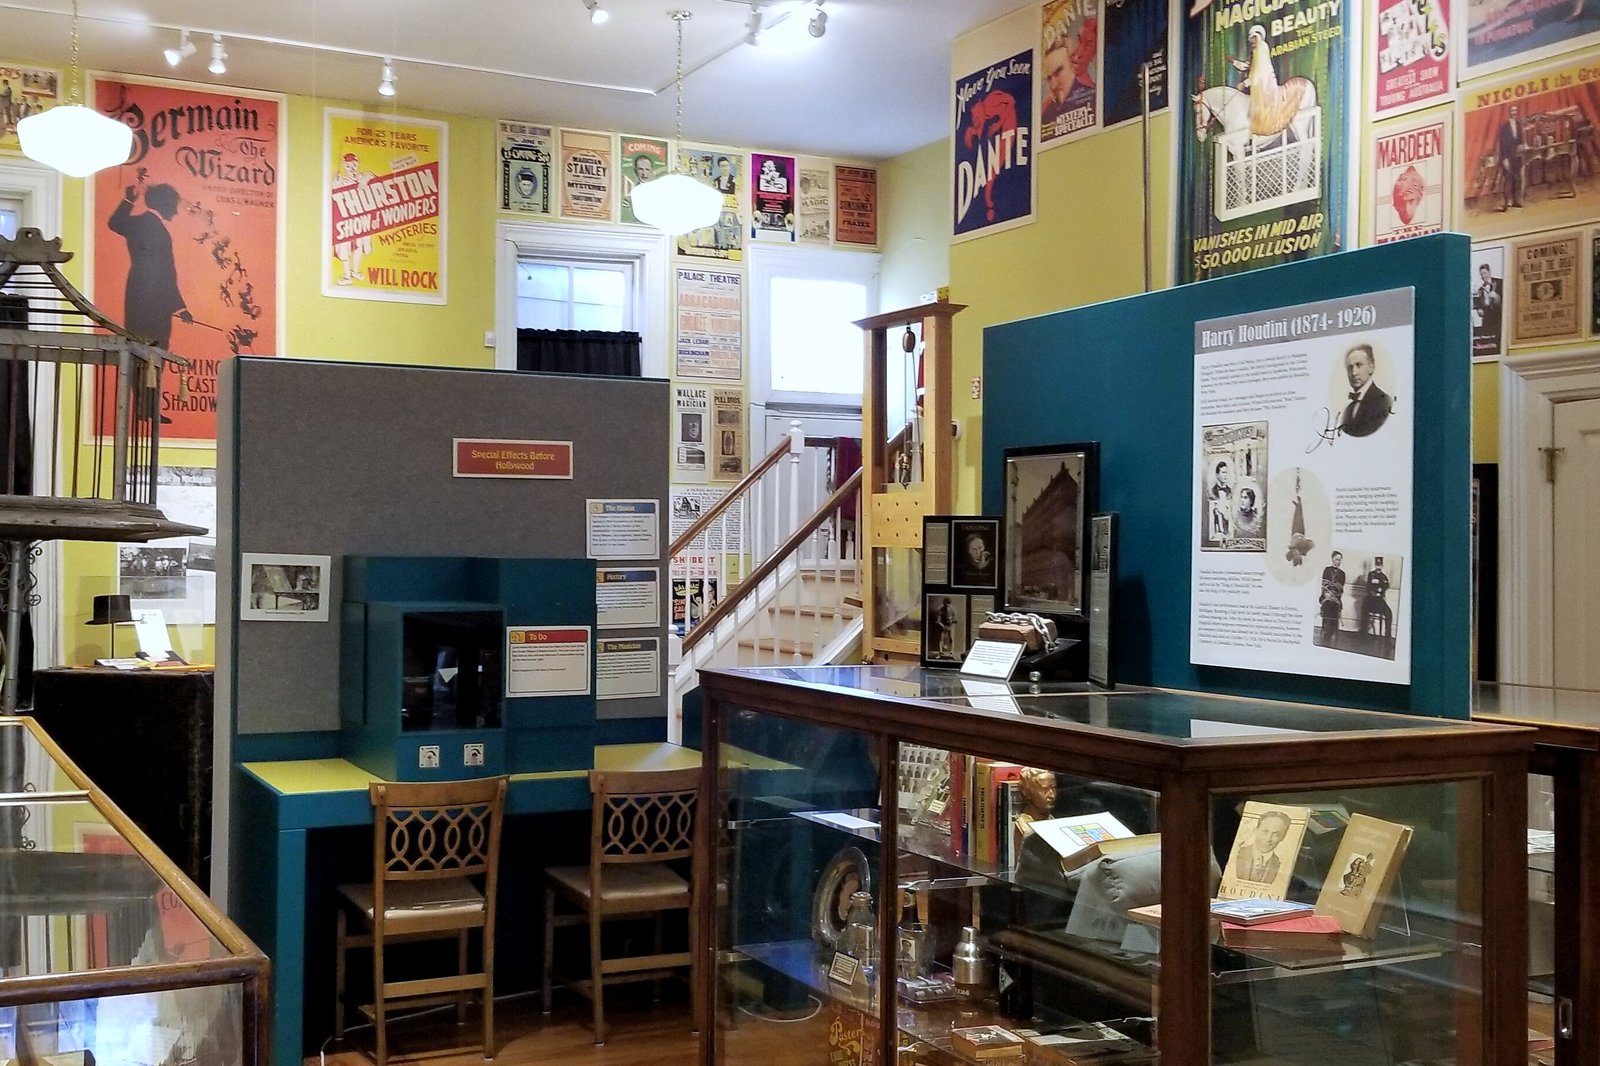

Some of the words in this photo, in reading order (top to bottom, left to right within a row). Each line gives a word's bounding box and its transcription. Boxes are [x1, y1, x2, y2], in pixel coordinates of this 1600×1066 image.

[1271, 0, 1340, 37] BEAUTY
[1296, 26, 1314, 37] THE
[1309, 25, 1342, 43] STEED
[1007, 58, 1031, 75] Seen
[1477, 78, 1549, 107] NICOLI
[356, 127, 373, 137] FOR
[375, 129, 386, 137] 25
[389, 131, 417, 141] YEARS
[345, 136, 387, 148] AMERICA'S
[390, 142, 429, 153] FAVORITE
[628, 142, 662, 155] COMING
[1377, 126, 1444, 170] MARDEEN
[176, 146, 276, 186] Wizard
[567, 163, 607, 177] STANLEY
[957, 126, 1029, 225] DANTE
[332, 168, 438, 219] THURSTON
[335, 214, 372, 241] SHOW
[371, 210, 381, 230] of
[382, 195, 438, 226] WONDERS
[379, 222, 438, 247] MYSTERIES
[1193, 227, 1254, 253] VANISHES
[1254, 223, 1272, 241] IN
[1270, 218, 1297, 238] MID
[1297, 212, 1324, 232] AIR
[1252, 232, 1323, 259] ILLUSION
[367, 266, 398, 287] WILL
[401, 269, 438, 290] ROCK
[678, 271, 706, 282] PALACE
[709, 274, 741, 285] THEATRE
[1201, 328, 1235, 348] Harry
[1238, 318, 1288, 343] Houdini
[1290, 311, 1333, 337] (1874-
[1336, 304, 1377, 329] 1926)
[676, 388, 707, 398] WALLACE
[676, 399, 706, 408] MAGICIAN
[471, 449, 500, 459] Special
[501, 450, 528, 460] Effects
[529, 451, 555, 461] Before
[495, 461, 535, 470] Hollywood
[672, 556, 716, 564] SHBET
[529, 633, 537, 641] To
[538, 633, 548, 641] Do
[1220, 885, 1281, 901] HOUDINI
